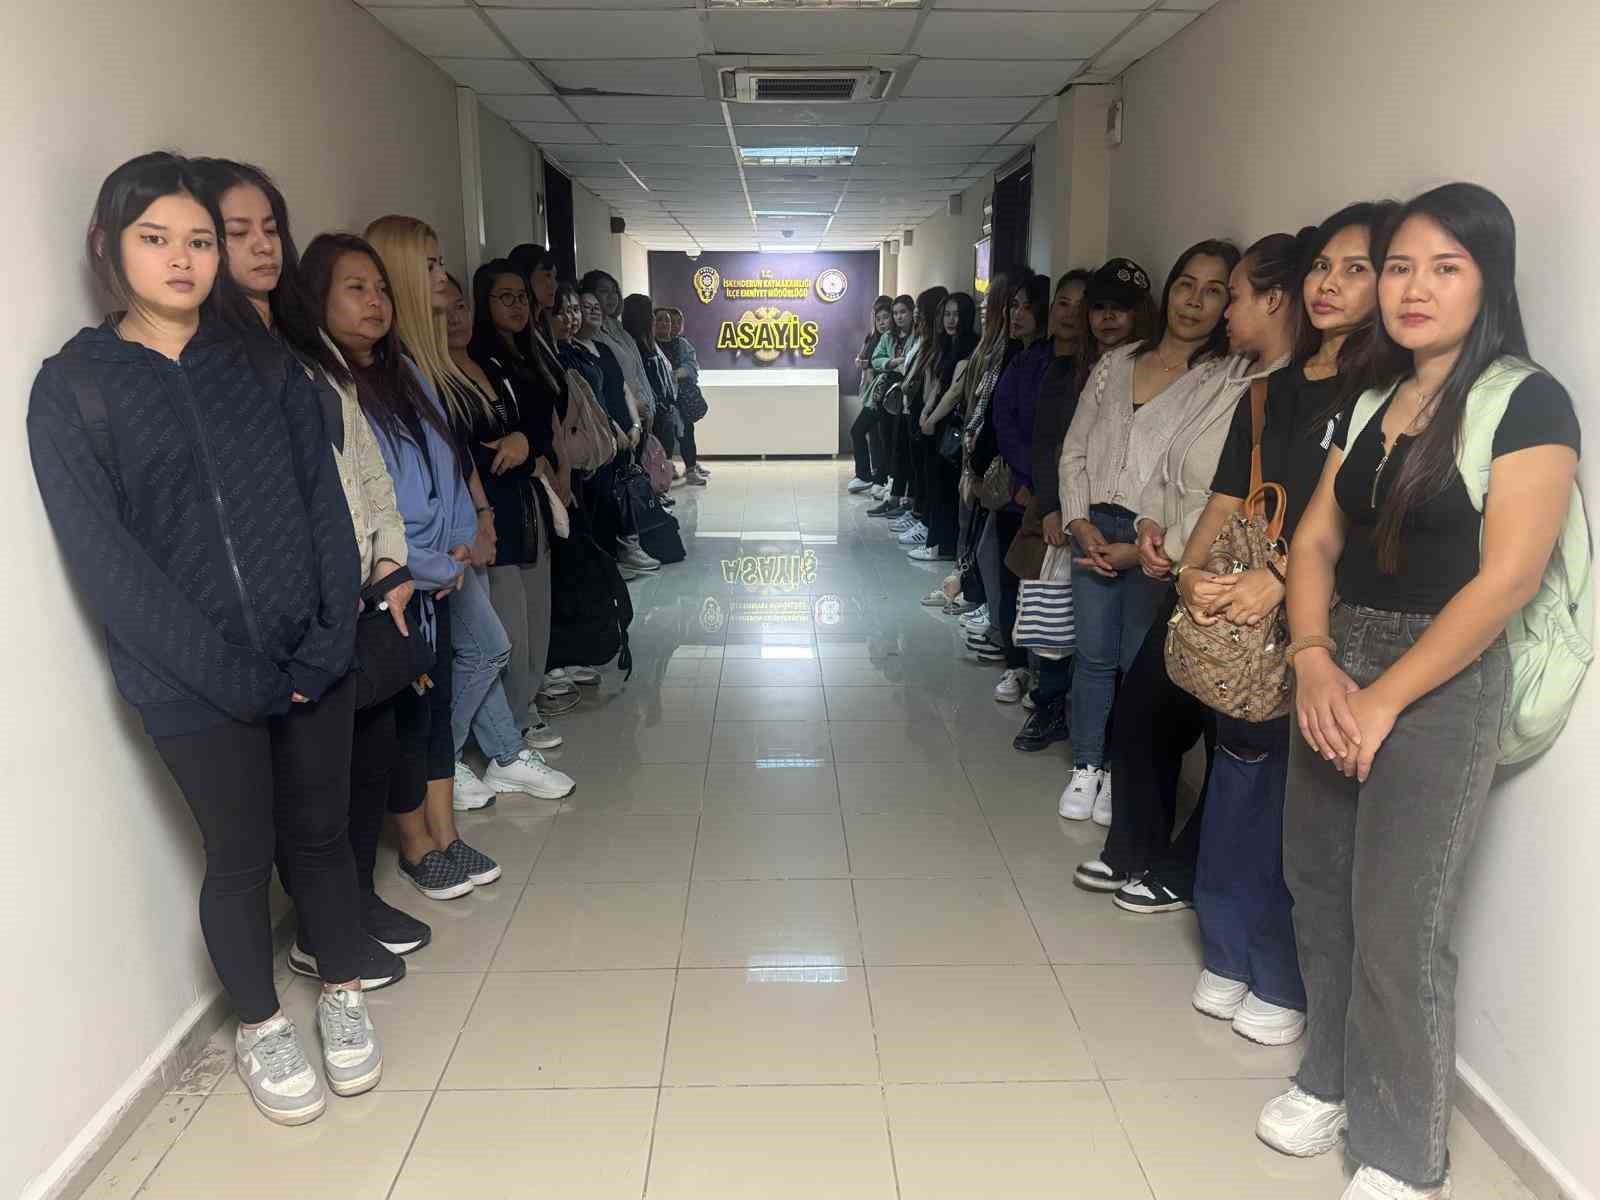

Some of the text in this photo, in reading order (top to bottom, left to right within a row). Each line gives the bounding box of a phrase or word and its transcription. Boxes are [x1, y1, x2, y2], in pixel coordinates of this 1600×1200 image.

[723, 278, 763, 288] İSKENDERUN
[726, 287, 808, 299] İLÇE EMNİYET MÜDÜRLÜĞÜ
[717, 315, 819, 357] ASAYİŞ
